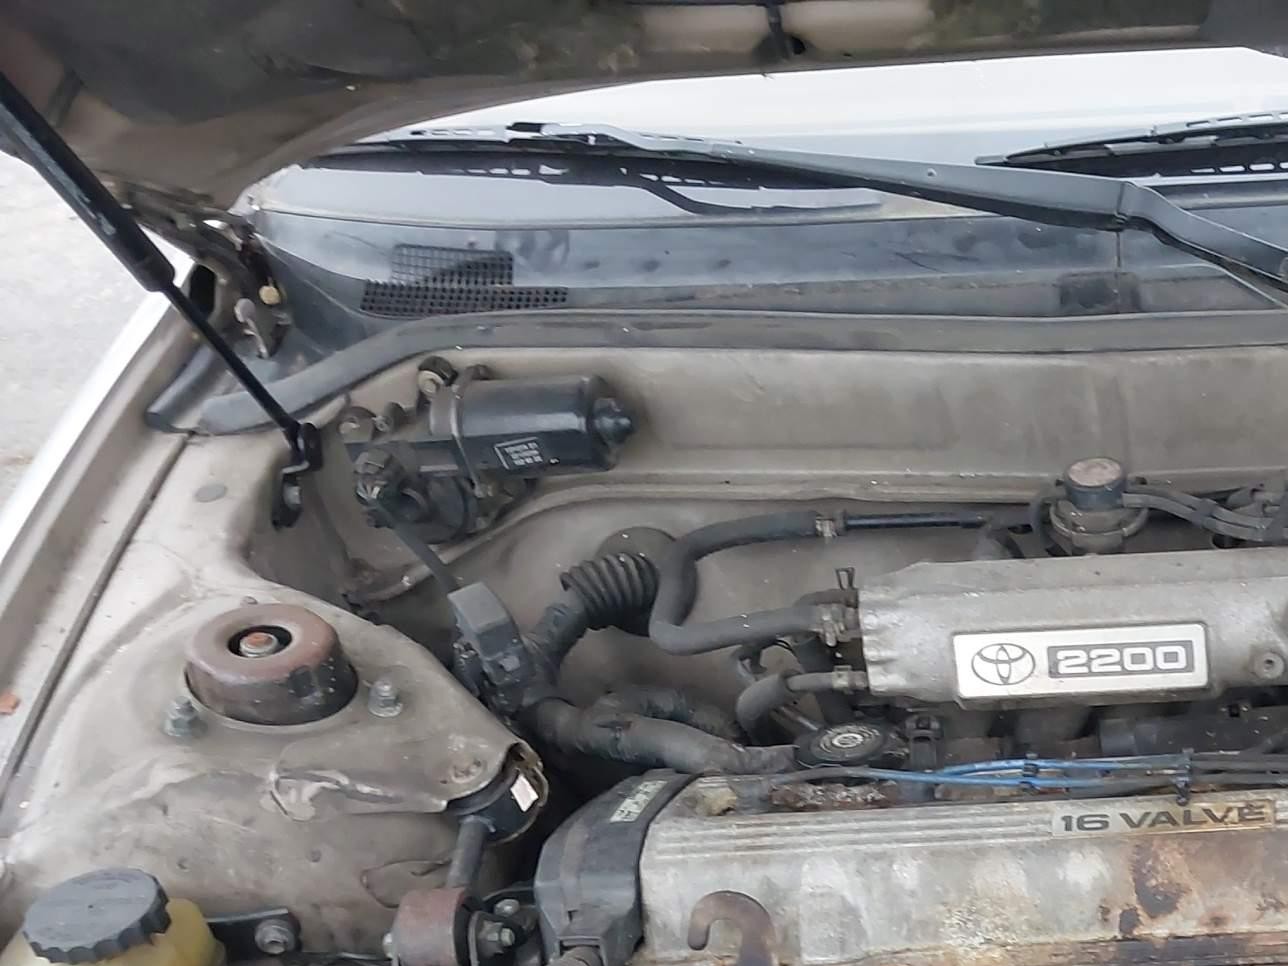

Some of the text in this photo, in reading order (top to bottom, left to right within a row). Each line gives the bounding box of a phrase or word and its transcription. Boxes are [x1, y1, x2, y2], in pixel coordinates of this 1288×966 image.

[1056, 645, 1187, 674] 2200
[1061, 802, 1266, 832] 16 VALVE
